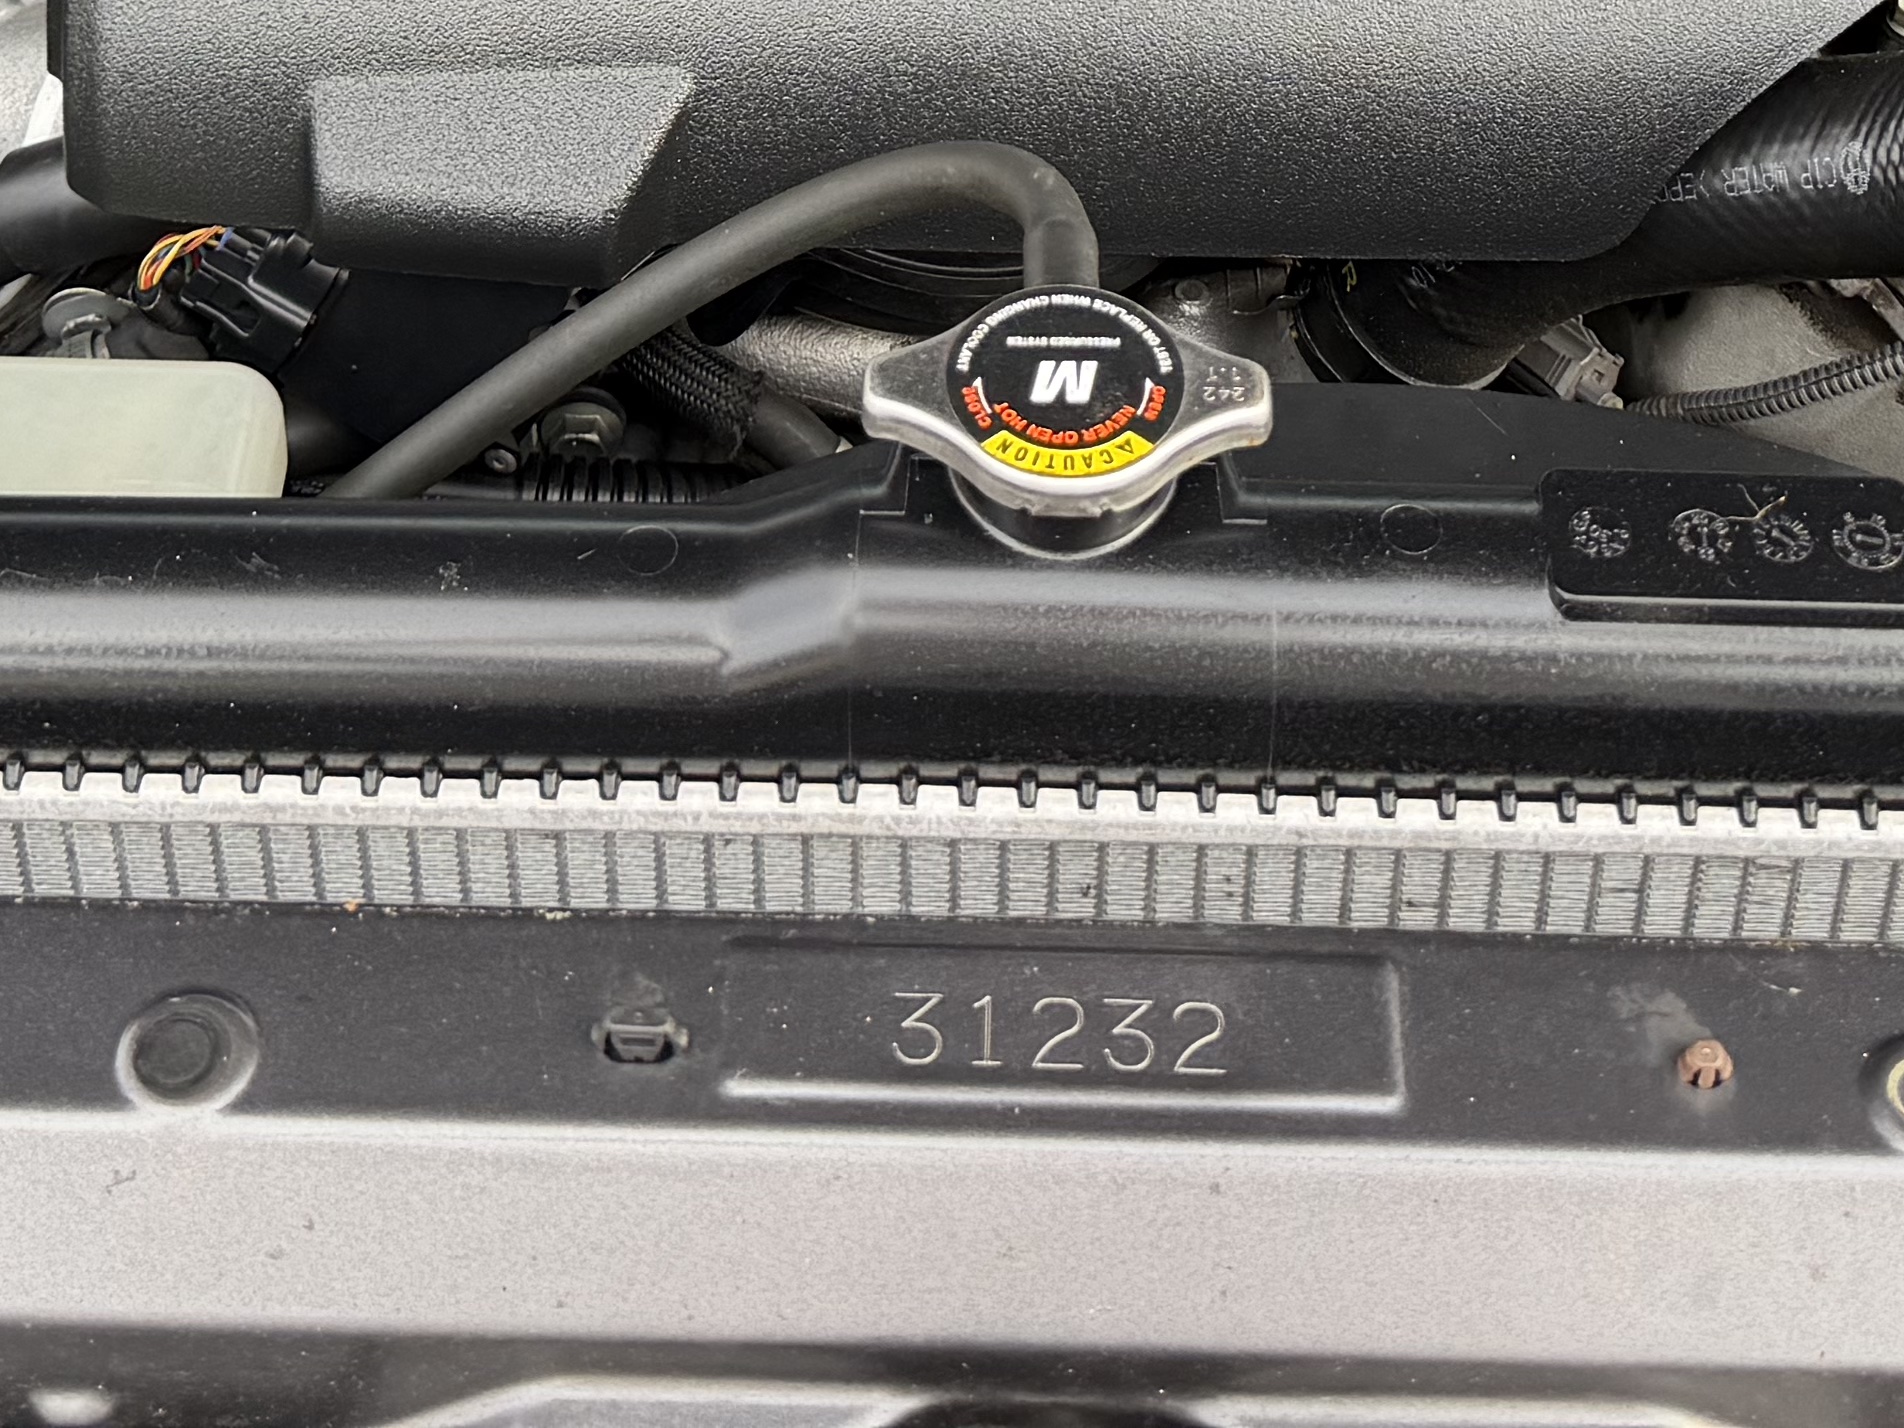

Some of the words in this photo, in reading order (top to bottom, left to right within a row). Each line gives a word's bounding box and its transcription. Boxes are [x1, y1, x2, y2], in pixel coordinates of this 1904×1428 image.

[1720, 161, 1789, 197] WATER
[984, 294, 1050, 327] CHANGING
[1051, 293, 1092, 308] WHEN
[1092, 298, 1148, 331] REPLACE
[954, 322, 990, 374] COOLANT
[1006, 335, 1049, 347] SYSTEM
[1143, 328, 1161, 347] OR
[1153, 345, 1173, 374] TEST
[1028, 359, 1099, 404] M
[1202, 386, 1245, 401] 242
[961, 385, 993, 430] CLOSE
[992, 402, 1028, 433] HOT
[1144, 385, 1167, 422] OPEN
[1026, 424, 1079, 445] OPEN
[1081, 405, 1136, 442] NEVER
[995, 438, 1114, 472] CAUTION
[888, 991, 1230, 1077] 31232
